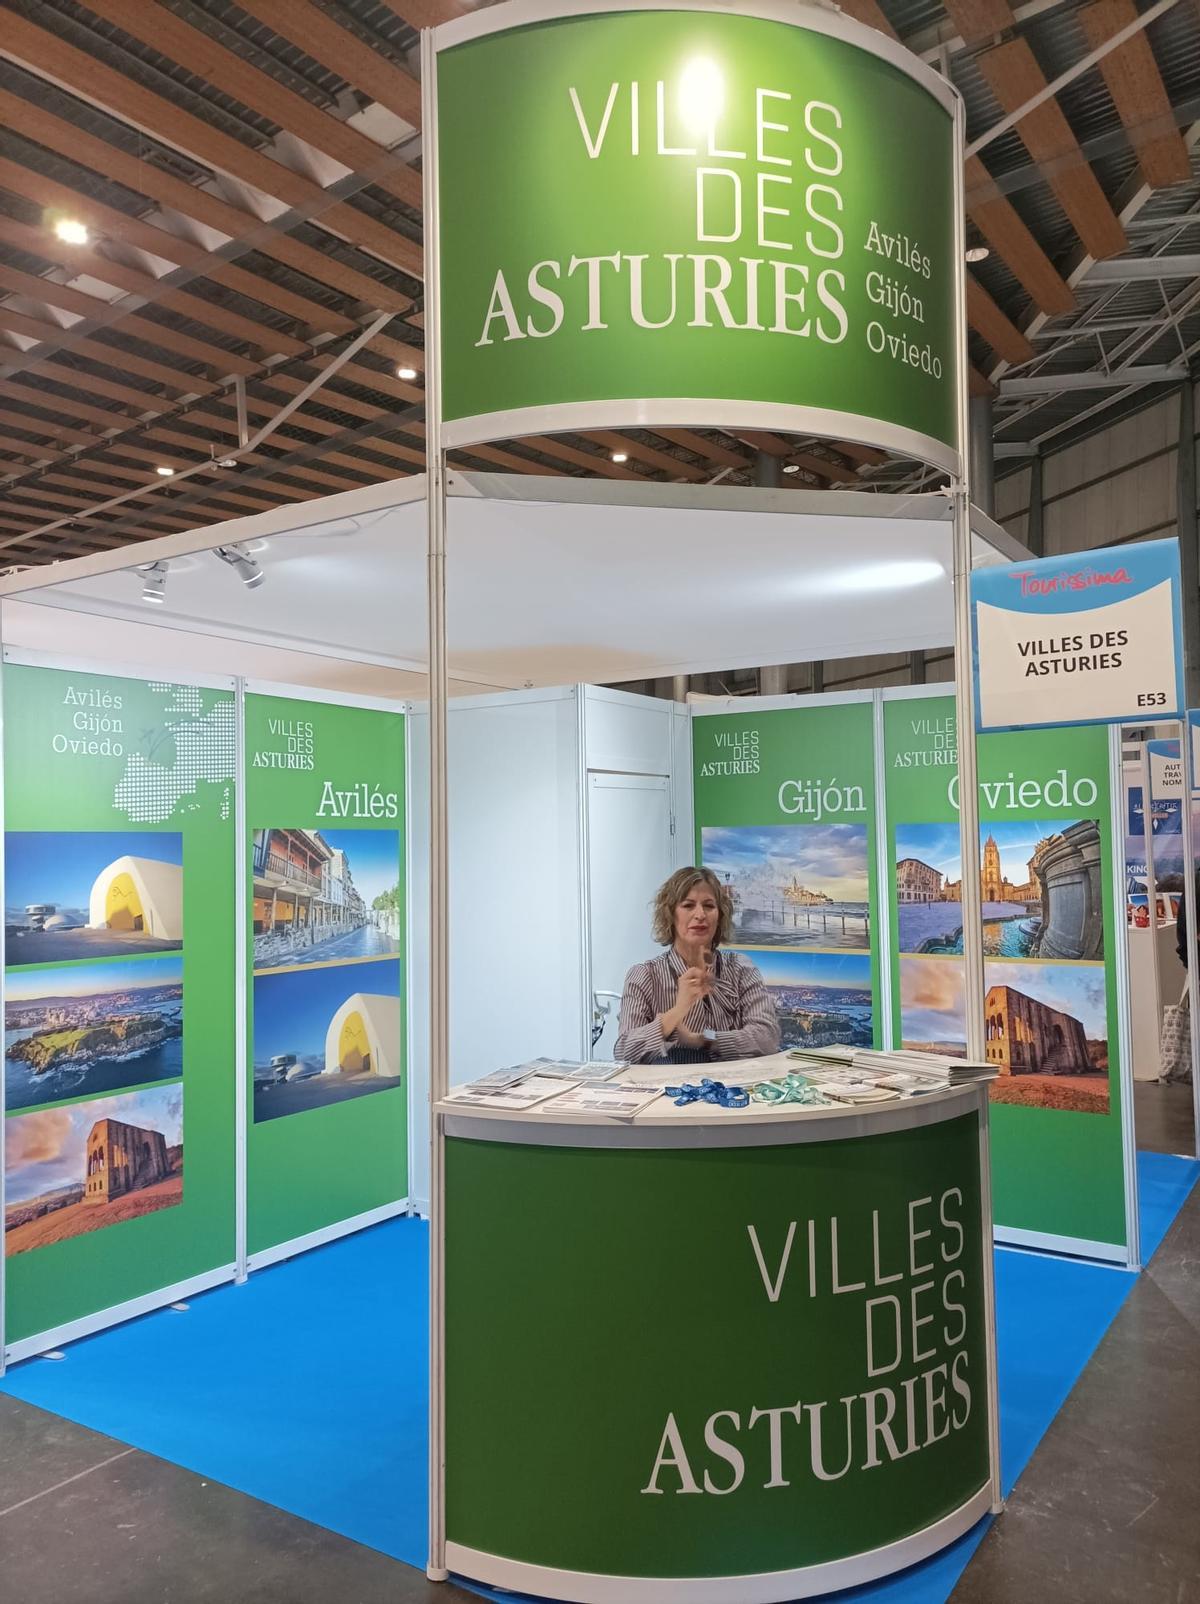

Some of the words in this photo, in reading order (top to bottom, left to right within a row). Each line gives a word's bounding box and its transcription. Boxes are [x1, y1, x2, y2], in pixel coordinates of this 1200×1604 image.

[568, 80, 843, 177] VILLES
[696, 166, 844, 259] DES
[864, 220, 932, 279] Avilés
[474, 250, 849, 347] ASTURIES
[865, 272, 925, 323] Gijón
[866, 322, 942, 379] Oviedo
[1009, 567, 1133, 597] Tourissima
[1017, 635, 1083, 657] VILLES
[1090, 630, 1128, 649] DES
[1025, 652, 1122, 677] ASTURIES
[63, 686, 123, 710] Avilés
[1137, 692, 1167, 707] E53
[72, 711, 124, 735] Gijón
[268, 718, 314, 738] VILLES
[911, 716, 957, 735] VILLE
[52, 734, 124, 757] Oviedo
[288, 736, 314, 754] DES
[714, 731, 760, 747] VILLES
[934, 733, 958, 750] DE
[252, 751, 314, 771] ASTURIES
[733, 745, 760, 760] DES
[894, 749, 959, 768] ASTURIE
[700, 759, 761, 777] ASTURIES
[316, 781, 398, 818] Avilés
[777, 777, 867, 821] Gijón
[746, 1187, 964, 1302] VILLES
[865, 1269, 967, 1377] DES
[640, 1350, 971, 1495] ASTURIES
